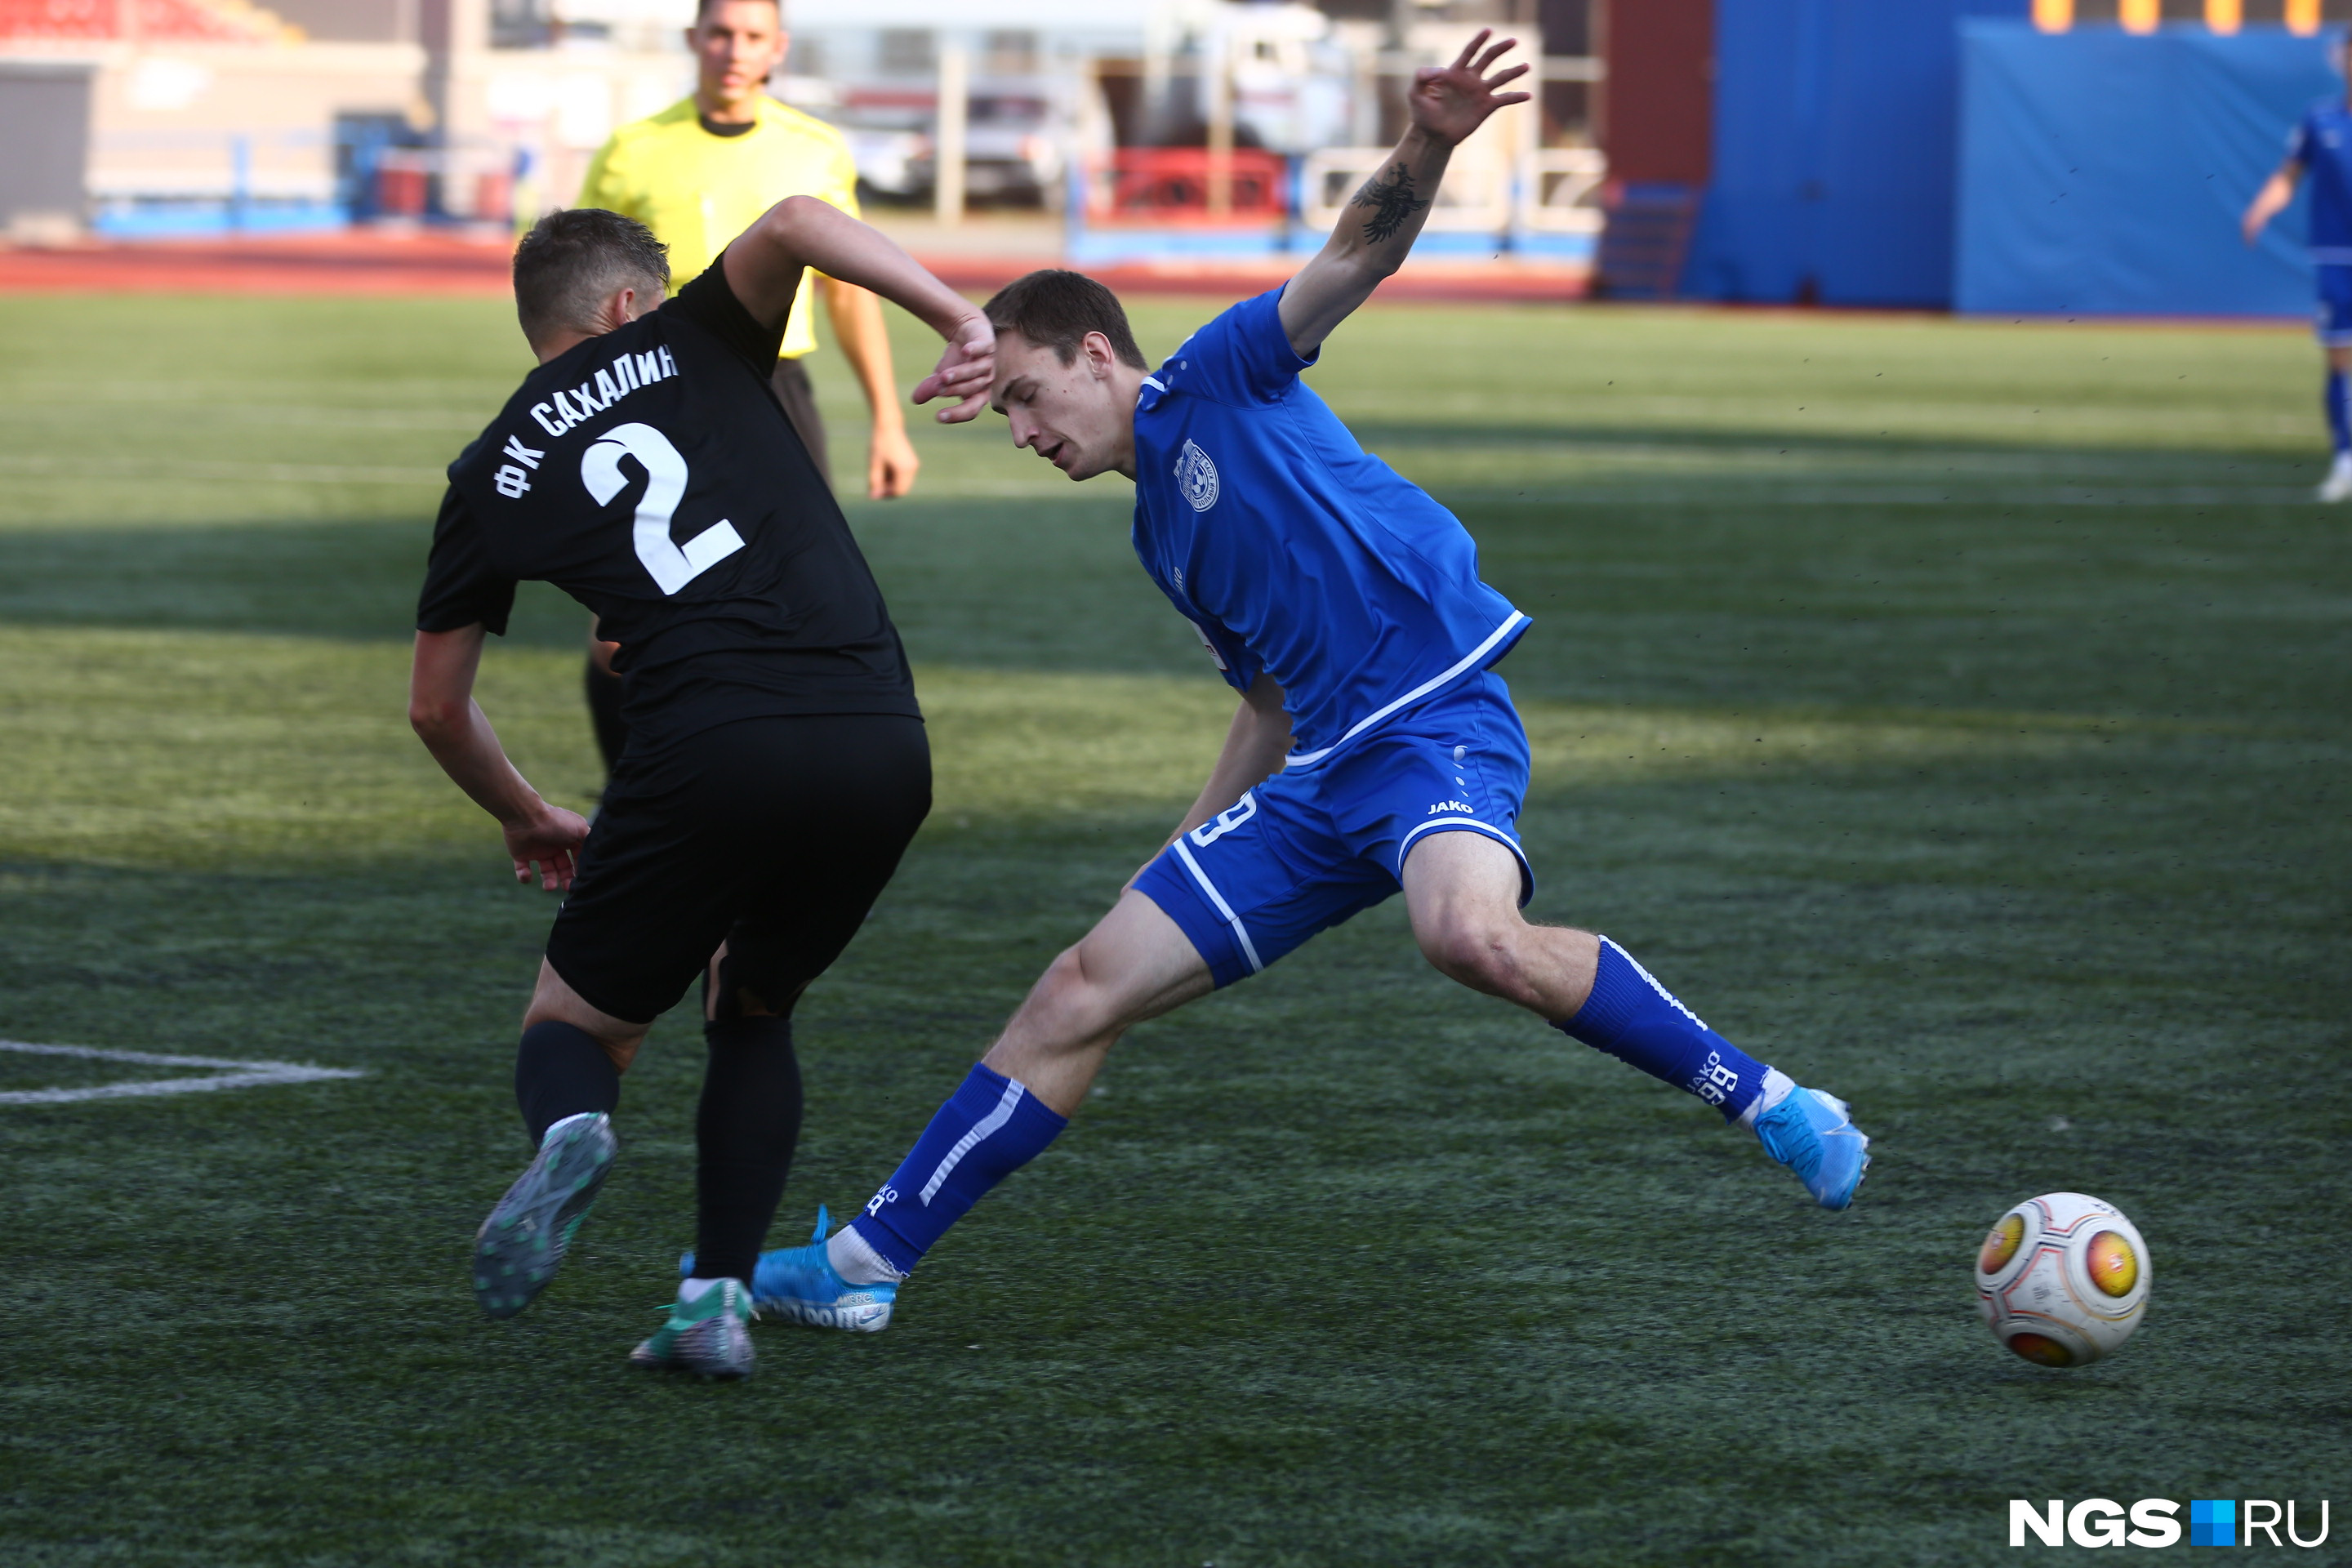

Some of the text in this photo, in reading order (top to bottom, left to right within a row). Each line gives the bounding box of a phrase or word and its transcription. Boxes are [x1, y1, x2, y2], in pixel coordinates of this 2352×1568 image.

[493, 344, 679, 499] ФК САХАЛИН
[581, 421, 746, 595] 2
[1192, 483, 1215, 506] ТБОЛЬНЫЙ
[1428, 800, 1474, 815] JAKO
[1686, 1049, 1721, 1093] JAKO
[1698, 1064, 1738, 1106] 99
